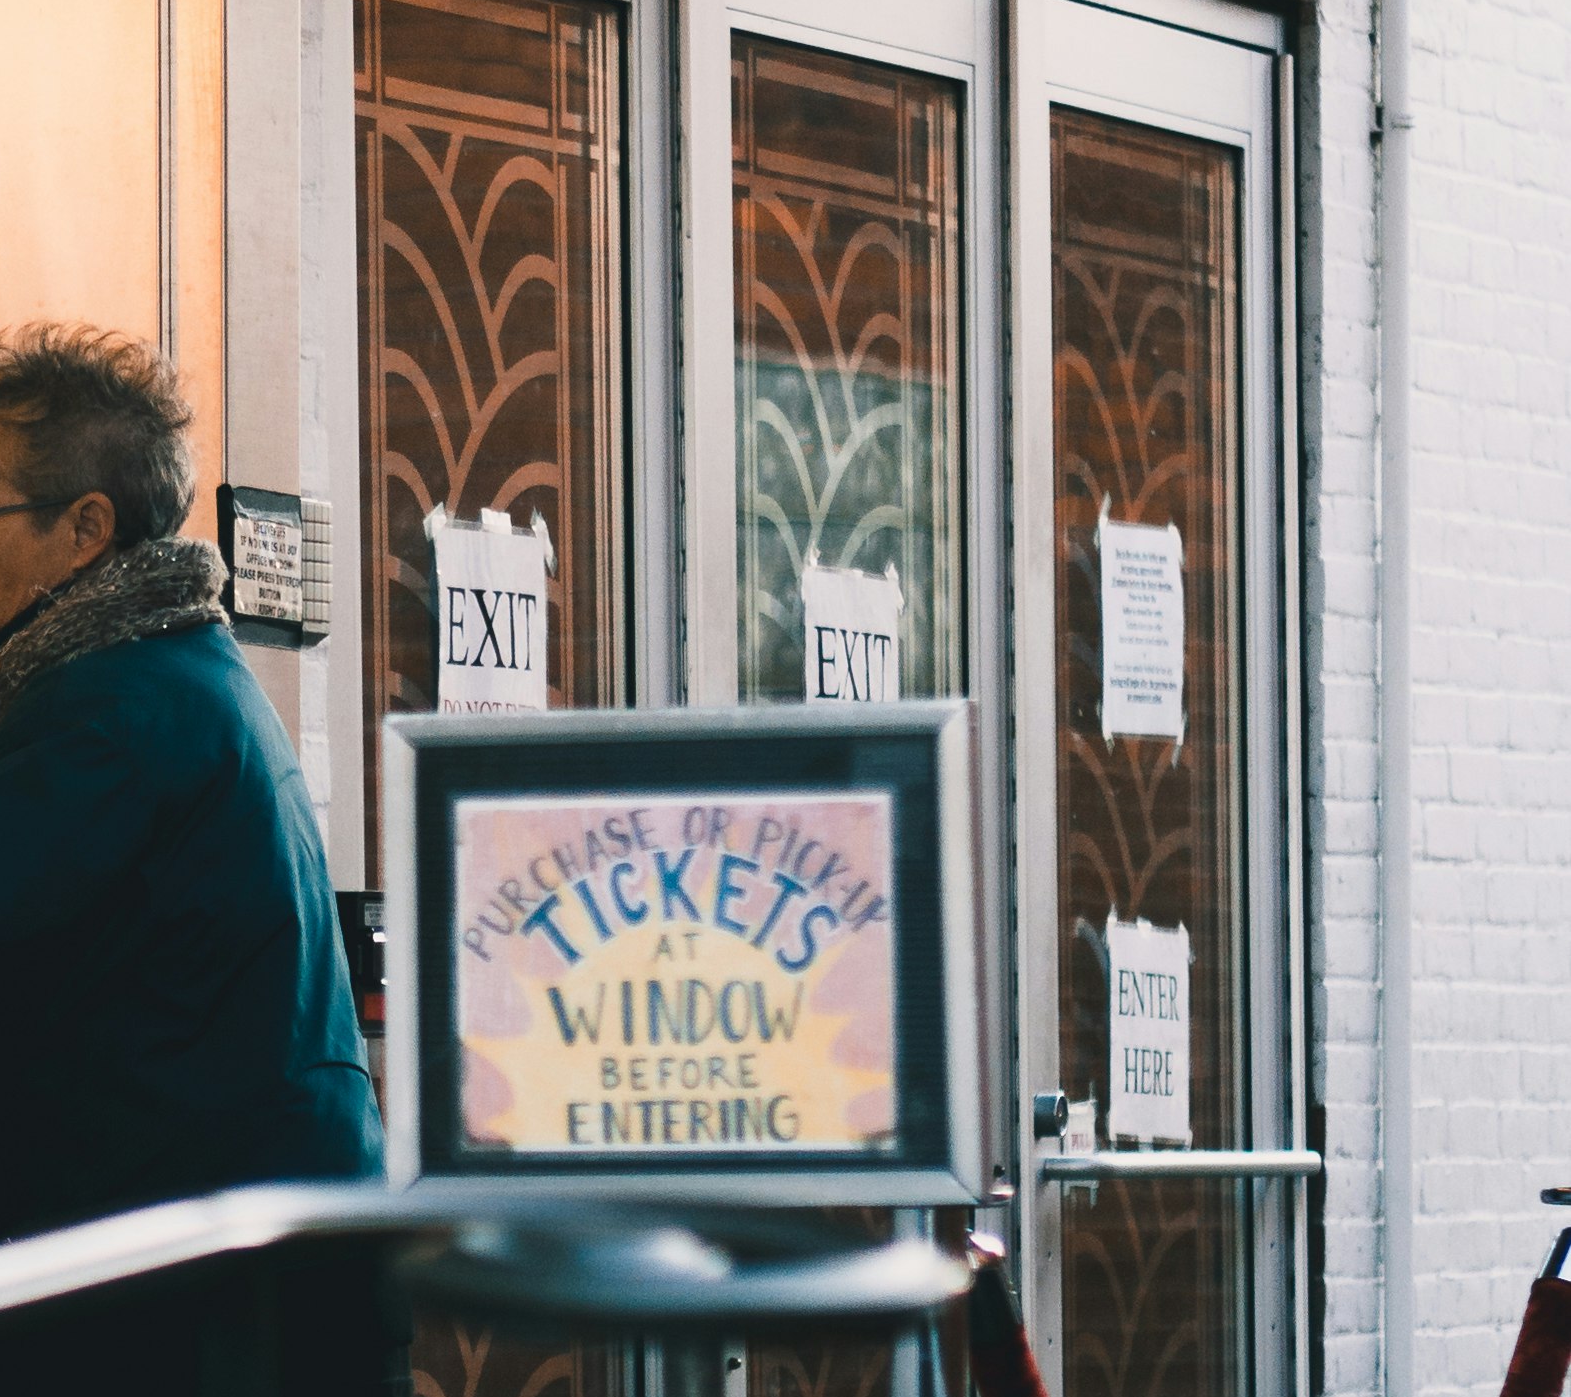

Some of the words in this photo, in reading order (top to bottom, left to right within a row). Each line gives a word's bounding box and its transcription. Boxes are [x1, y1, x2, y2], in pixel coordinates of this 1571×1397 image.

[234, 566, 256, 581] PLEASE
[257, 570, 275, 584] PRESS
[446, 586, 537, 671] EXIT
[814, 625, 892, 702] EXIT
[463, 807, 660, 962] PURCHASE
[684, 806, 733, 849] OR
[751, 816, 890, 933] PICK-UP
[520, 847, 841, 975] TICKETS
[653, 932, 702, 965] AT
[546, 979, 805, 1045] WINDOW
[1118, 969, 1180, 1022] ENTER
[600, 1054, 761, 1091] BEFORE
[1123, 1047, 1175, 1098] HERE
[566, 1094, 802, 1145] ENTERING
